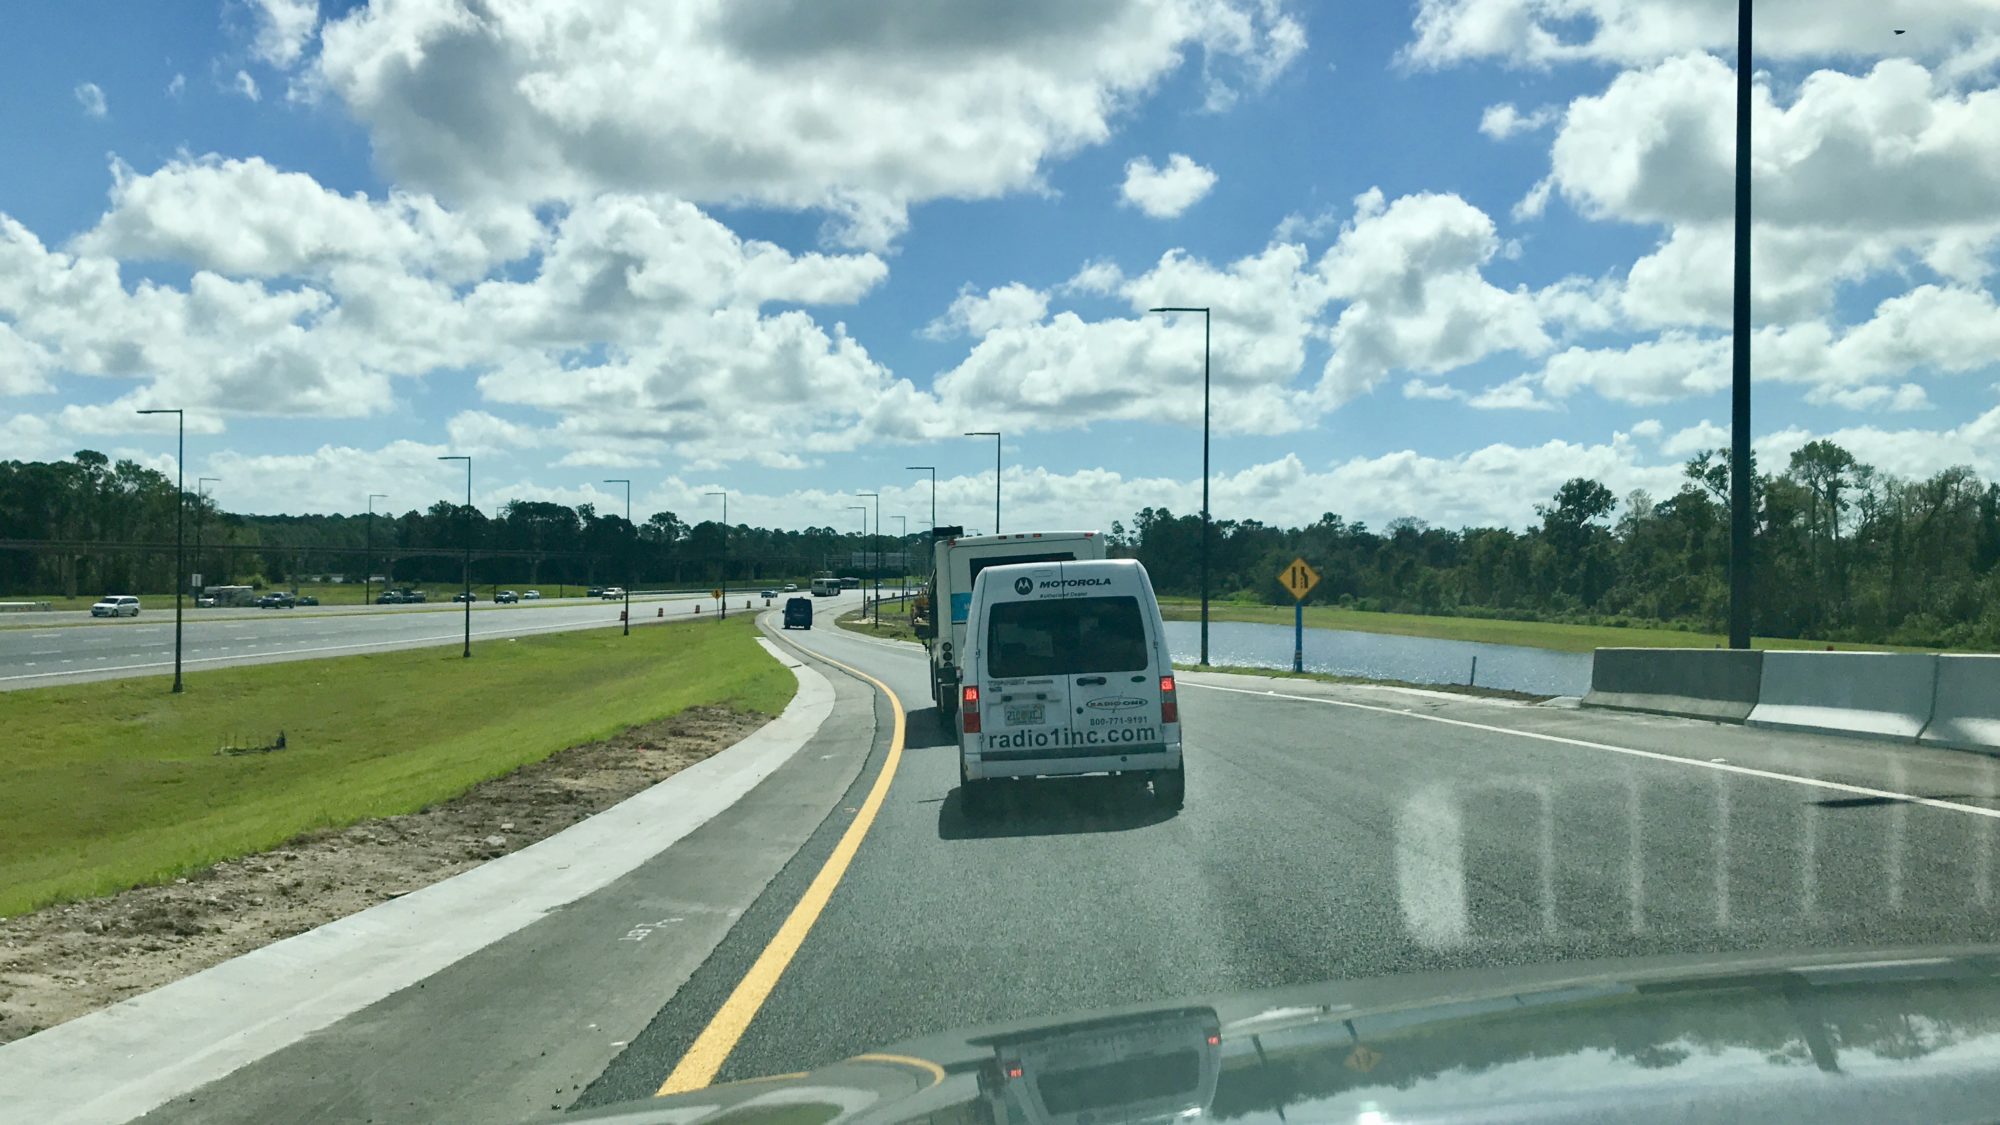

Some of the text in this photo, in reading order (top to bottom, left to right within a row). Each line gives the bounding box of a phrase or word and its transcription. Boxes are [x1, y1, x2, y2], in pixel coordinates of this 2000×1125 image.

[1039, 577, 1112, 588] MOTOROLA
[1090, 716, 1148, 726] 800-771-9191
[988, 727, 1156, 748] radio1inc.com
